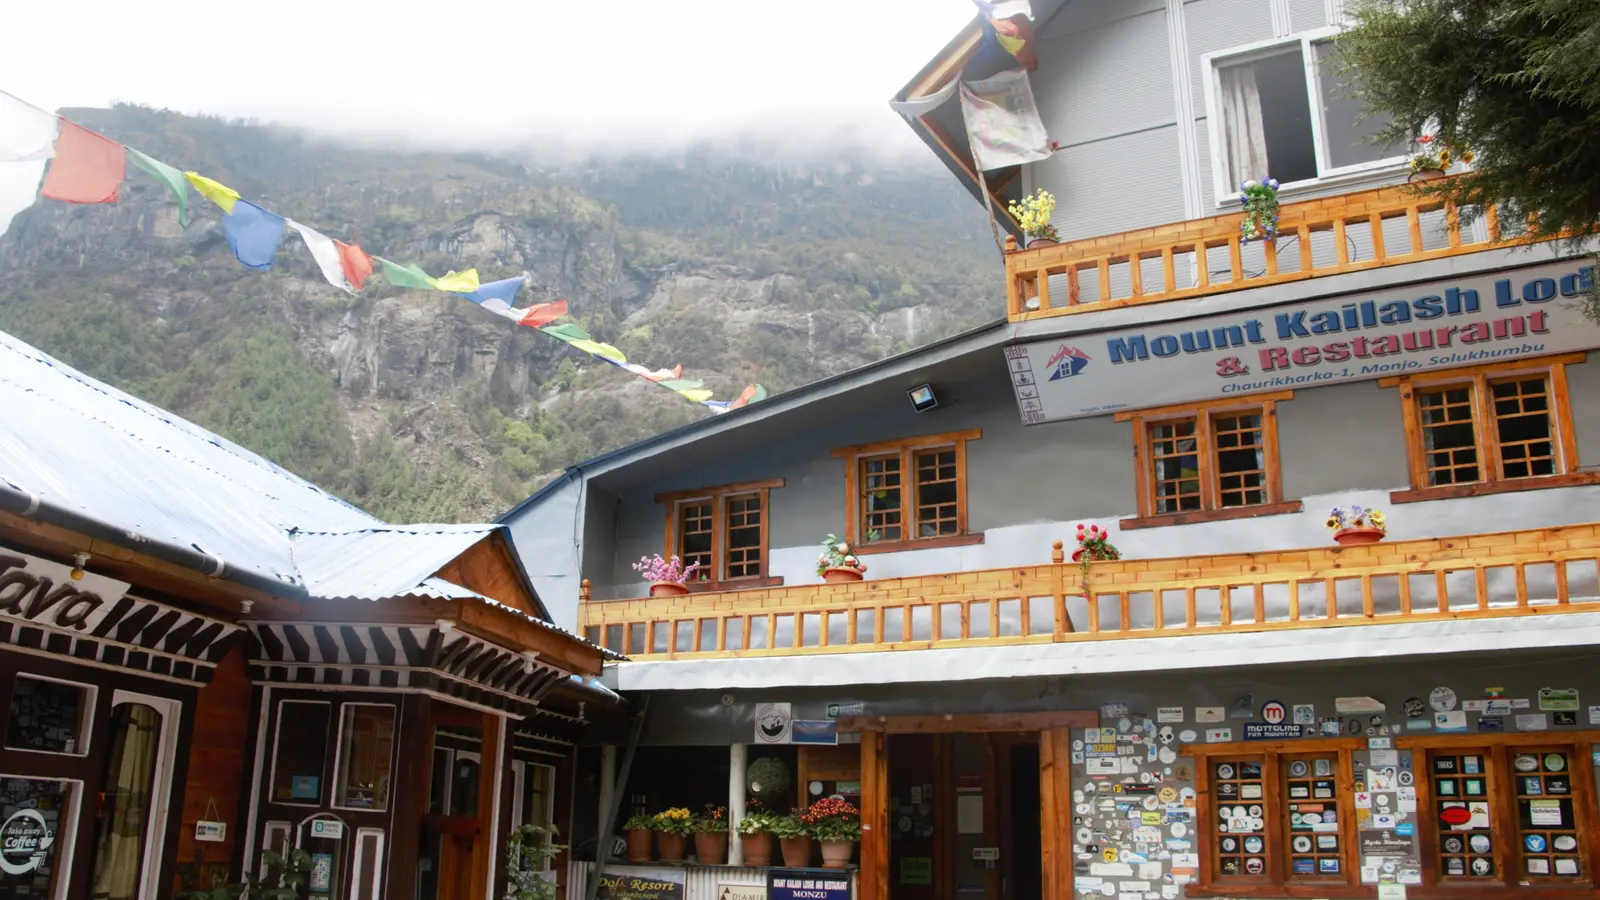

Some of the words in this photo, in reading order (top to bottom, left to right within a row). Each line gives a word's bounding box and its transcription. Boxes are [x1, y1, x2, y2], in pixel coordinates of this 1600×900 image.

[1107, 318, 1265, 364] Mount
[1274, 286, 1480, 341] Kailash
[1495, 266, 1595, 309] Lod
[1216, 356, 1249, 377] &
[1258, 309, 1550, 372] Restaurant
[1221, 369, 1354, 393] Chaurikharka-1,
[1361, 360, 1422, 374] Monjo,
[1429, 343, 1545, 366] Solukhumbu
[5, 836, 37, 848] Coffee
[630, 879, 675, 891] Resort
[792, 890, 827, 899] MONZU
